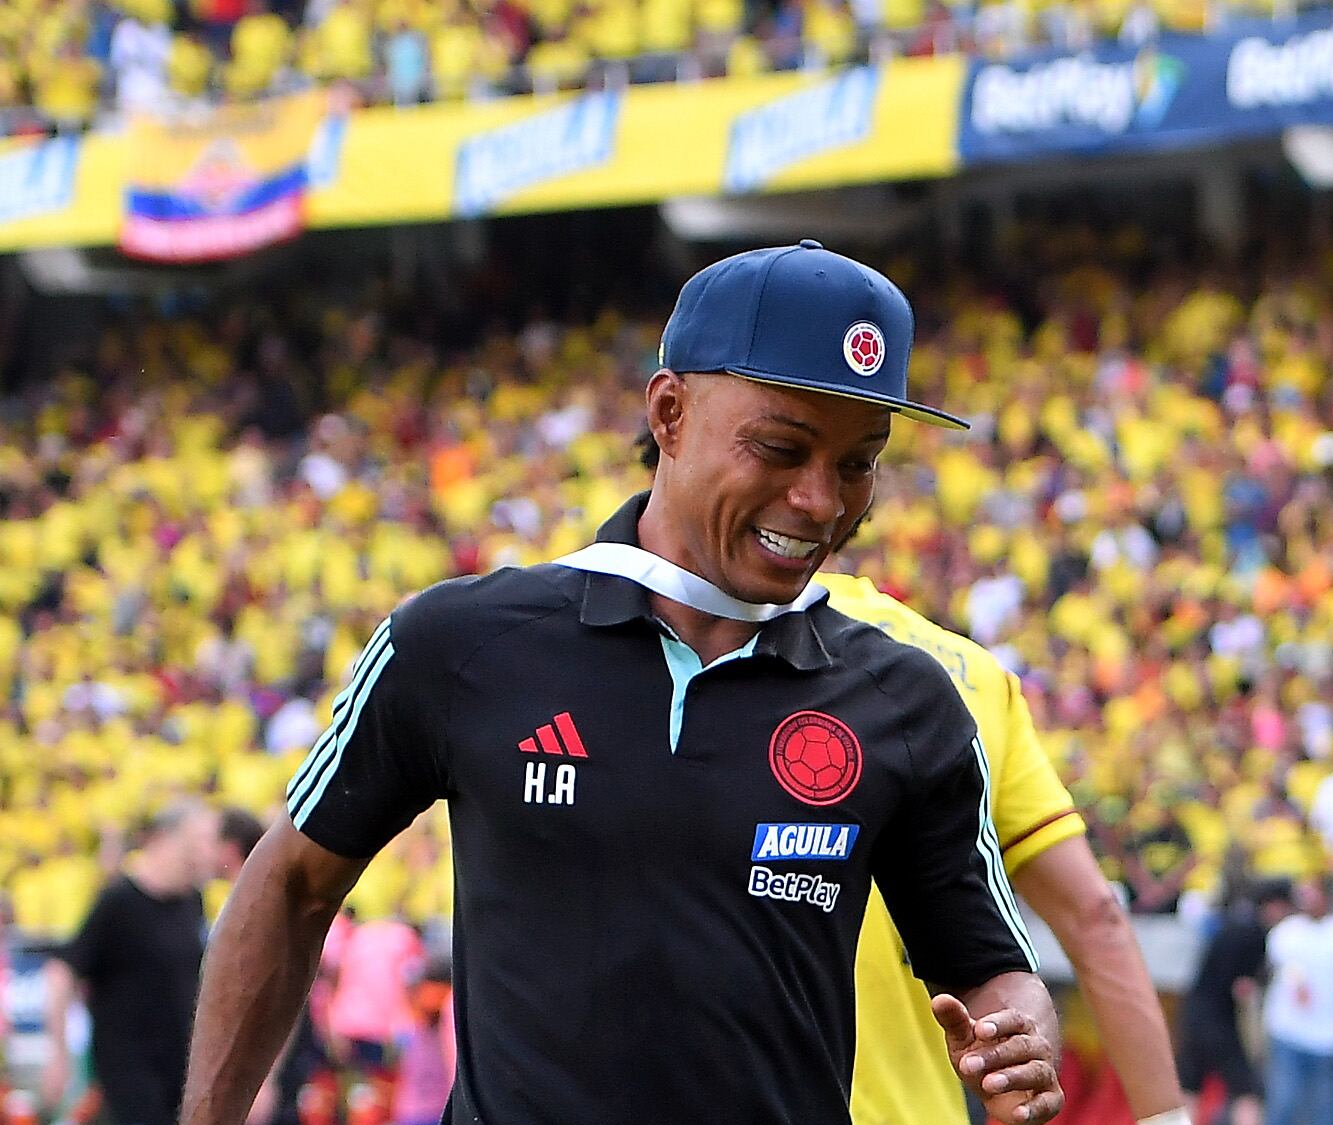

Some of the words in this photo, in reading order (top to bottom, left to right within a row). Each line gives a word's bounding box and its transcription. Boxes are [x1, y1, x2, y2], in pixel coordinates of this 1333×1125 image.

[523, 761, 576, 805] H.A
[757, 826, 849, 858] AGUILA
[749, 867, 839, 911] BetPlay
